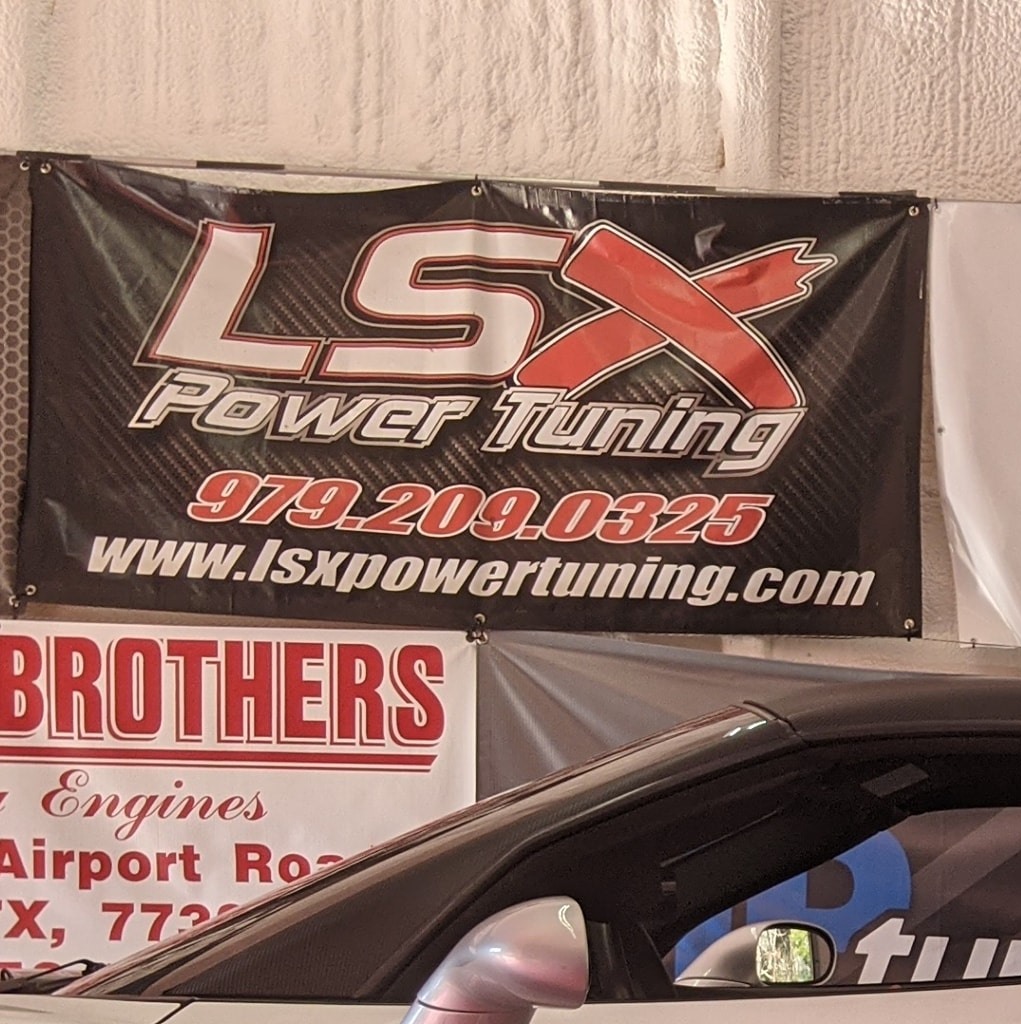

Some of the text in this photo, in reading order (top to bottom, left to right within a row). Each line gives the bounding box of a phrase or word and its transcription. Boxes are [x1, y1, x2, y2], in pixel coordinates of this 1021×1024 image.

[136, 219, 838, 411] LSX
[129, 370, 806, 478] Power Tuning
[186, 470, 775, 545] 979.209.0325
[86, 536, 876, 608] www.lsxpowertuning.com
[0, 634, 446, 748] BROTHERS
[40, 768, 269, 841] Engines
[0, 900, 66, 948] X,
